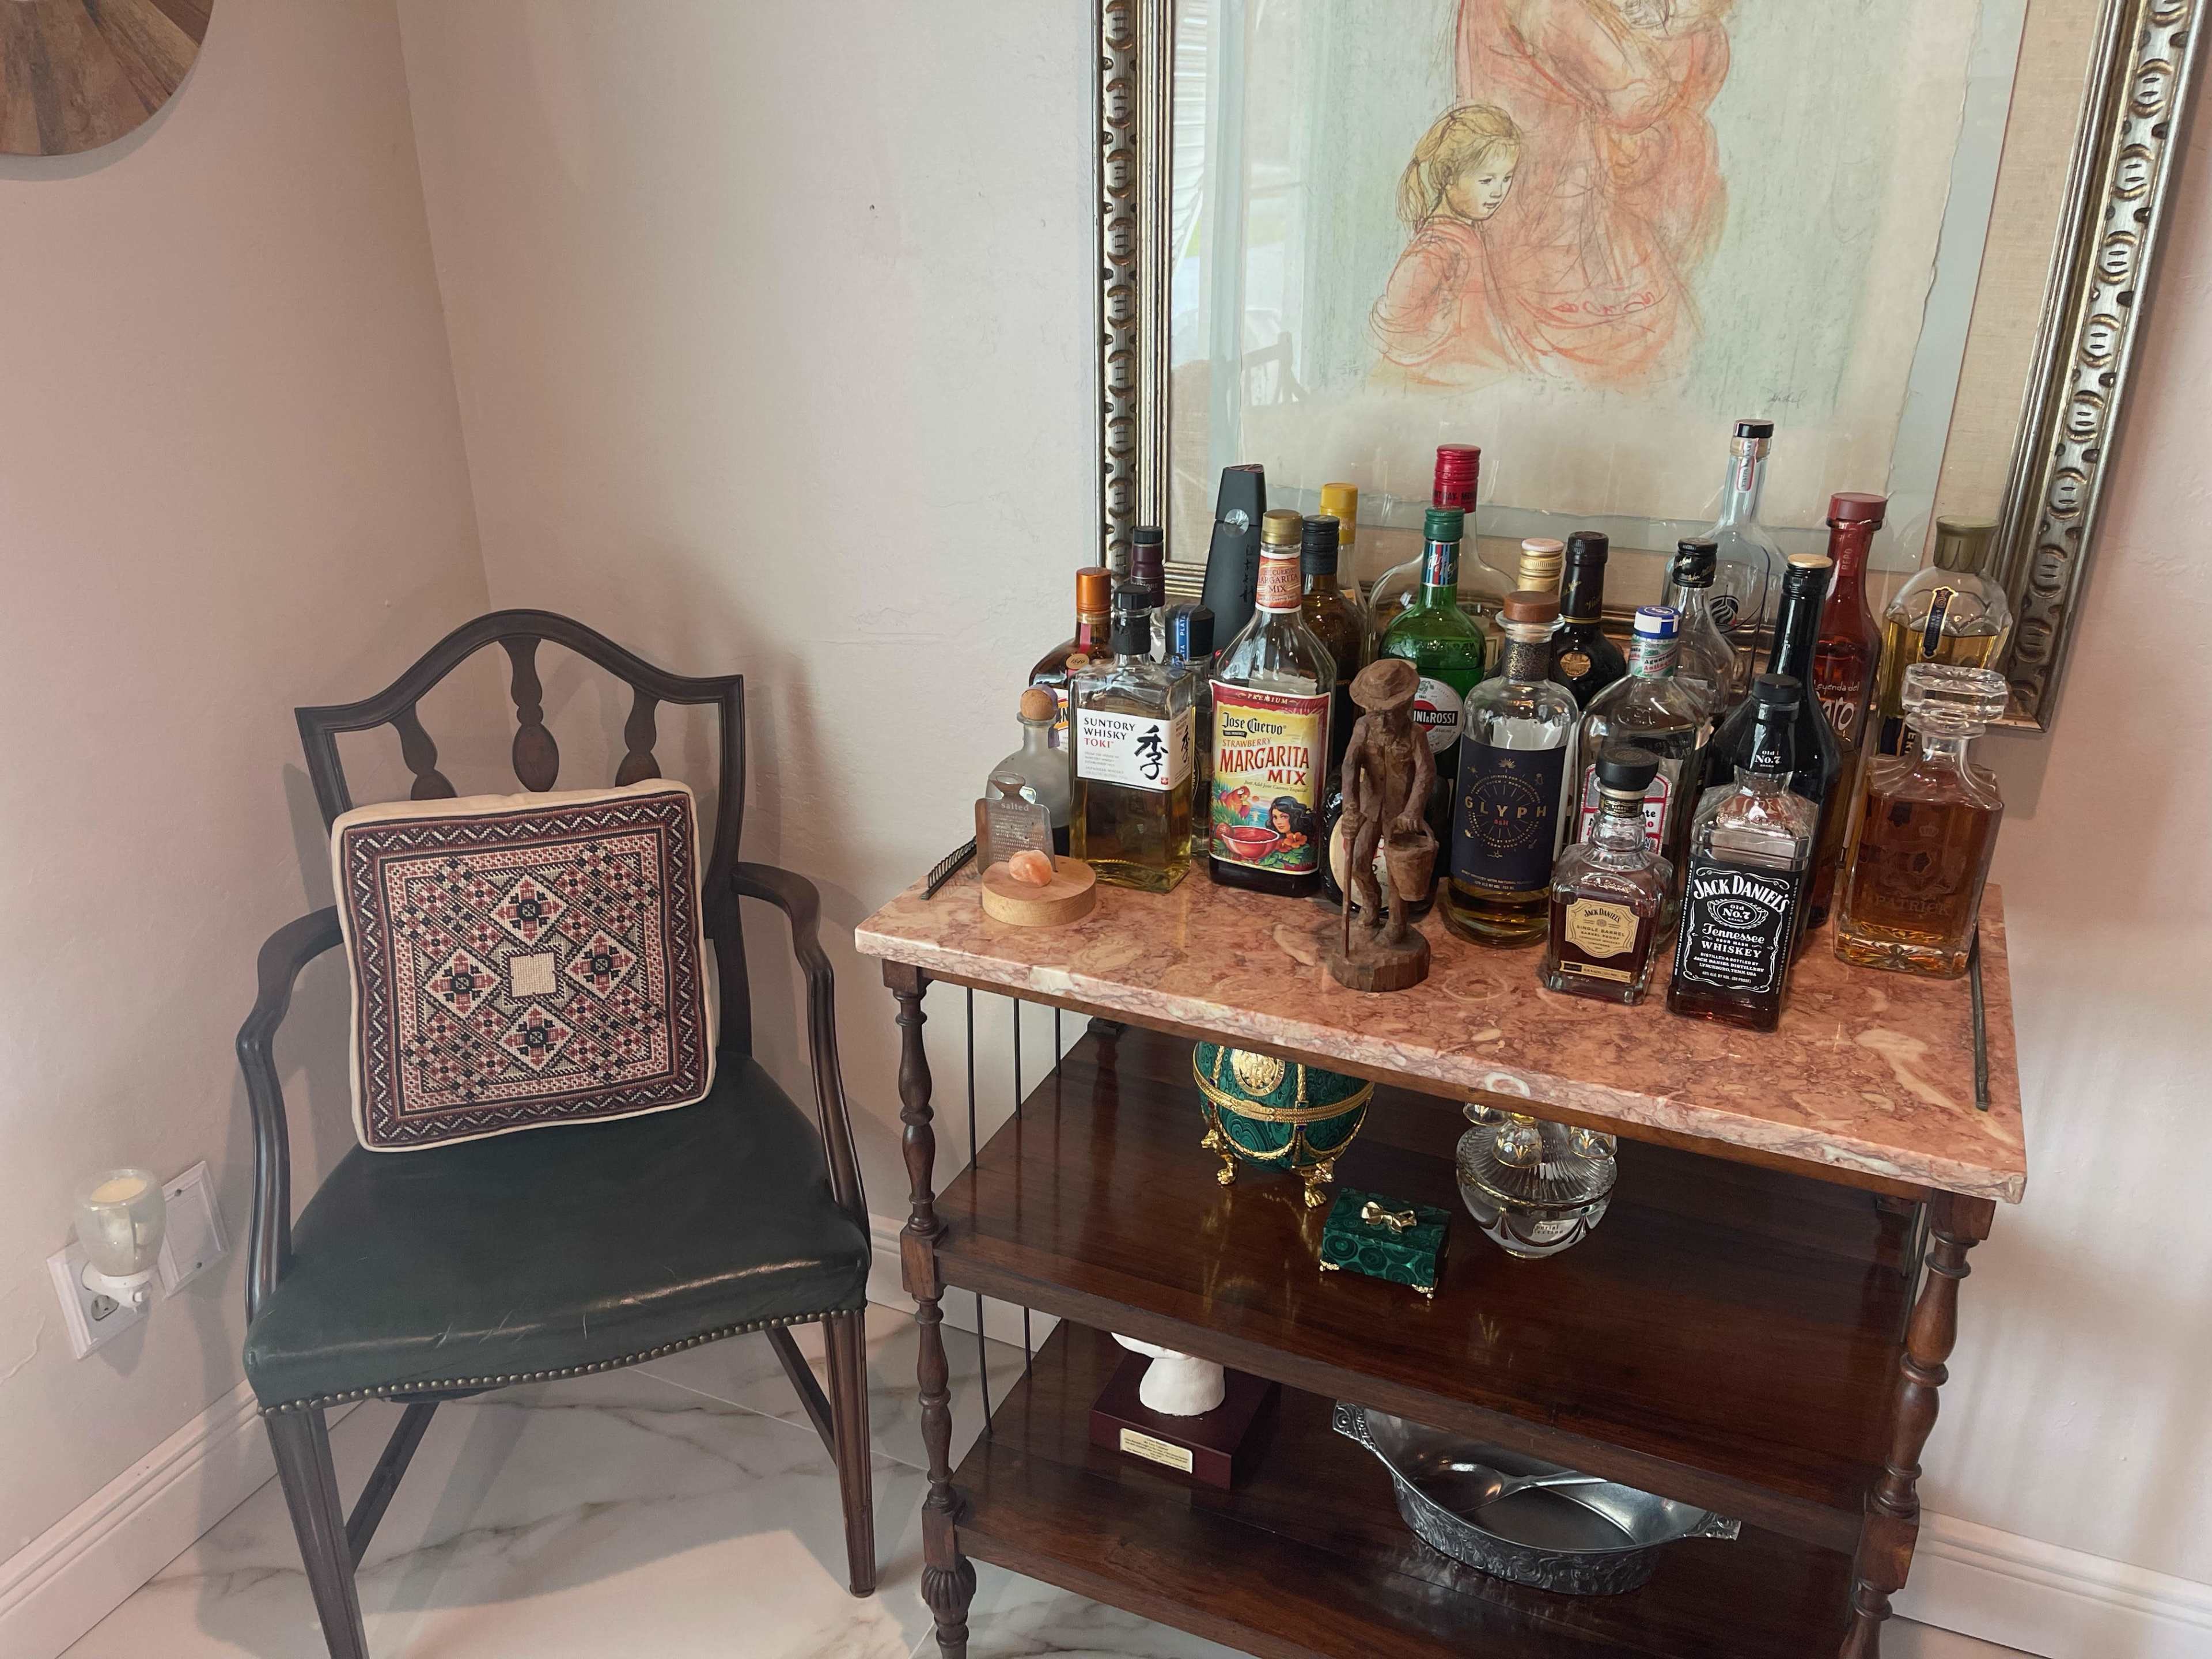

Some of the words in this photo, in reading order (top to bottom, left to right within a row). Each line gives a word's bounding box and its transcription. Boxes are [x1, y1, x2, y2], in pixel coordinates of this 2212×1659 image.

[1268, 585, 1286, 593] MIX
[1847, 681, 1860, 691] del
[1247, 694, 1288, 704] PREMIUM
[1084, 717, 1136, 731] SUNTORY
[1222, 712, 1245, 729] Jose
[1247, 718, 1283, 734] Cuervo
[1084, 728, 1127, 740] WHISKY
[1084, 738, 1111, 748] TOKI
[1222, 737, 1271, 748] STRAWBERRY
[1134, 724, 1169, 780] 季
[1219, 745, 1309, 773] MARGARITA
[1754, 755, 1781, 764] No.7
[1267, 769, 1307, 786] MIX
[1465, 796, 1547, 819] GLYPH
[1693, 878, 1730, 899] JACK
[1732, 875, 1790, 913] DANIEL'S
[1584, 909, 1599, 917] JACK
[1722, 908, 1751, 920] No.7
[1601, 929, 1625, 937] BARREL
[1702, 923, 1765, 944] Tennessee
[1701, 940, 1762, 958] WHISKEY
[1700, 952, 1725, 960] DISTILLED
[1729, 957, 1751, 965] BOTTLED
[1730, 963, 1764, 972] DISTILLERY
